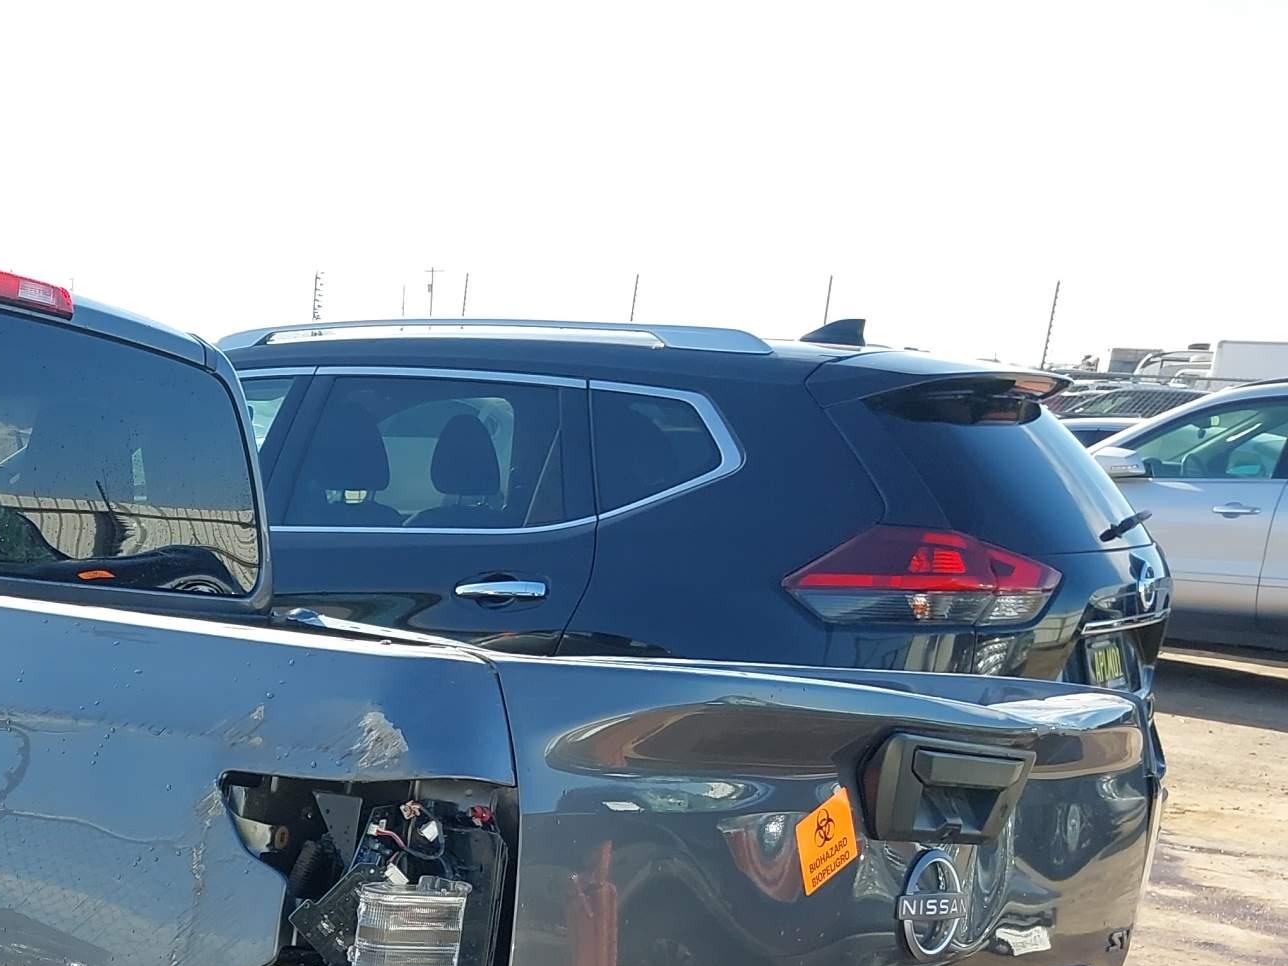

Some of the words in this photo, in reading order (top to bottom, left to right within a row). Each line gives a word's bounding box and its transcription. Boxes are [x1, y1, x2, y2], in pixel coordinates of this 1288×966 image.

[808, 836, 848, 874] BIOHAZARD
[811, 850, 850, 888] BIOPELIGRO
[902, 898, 967, 916] NISSAN
